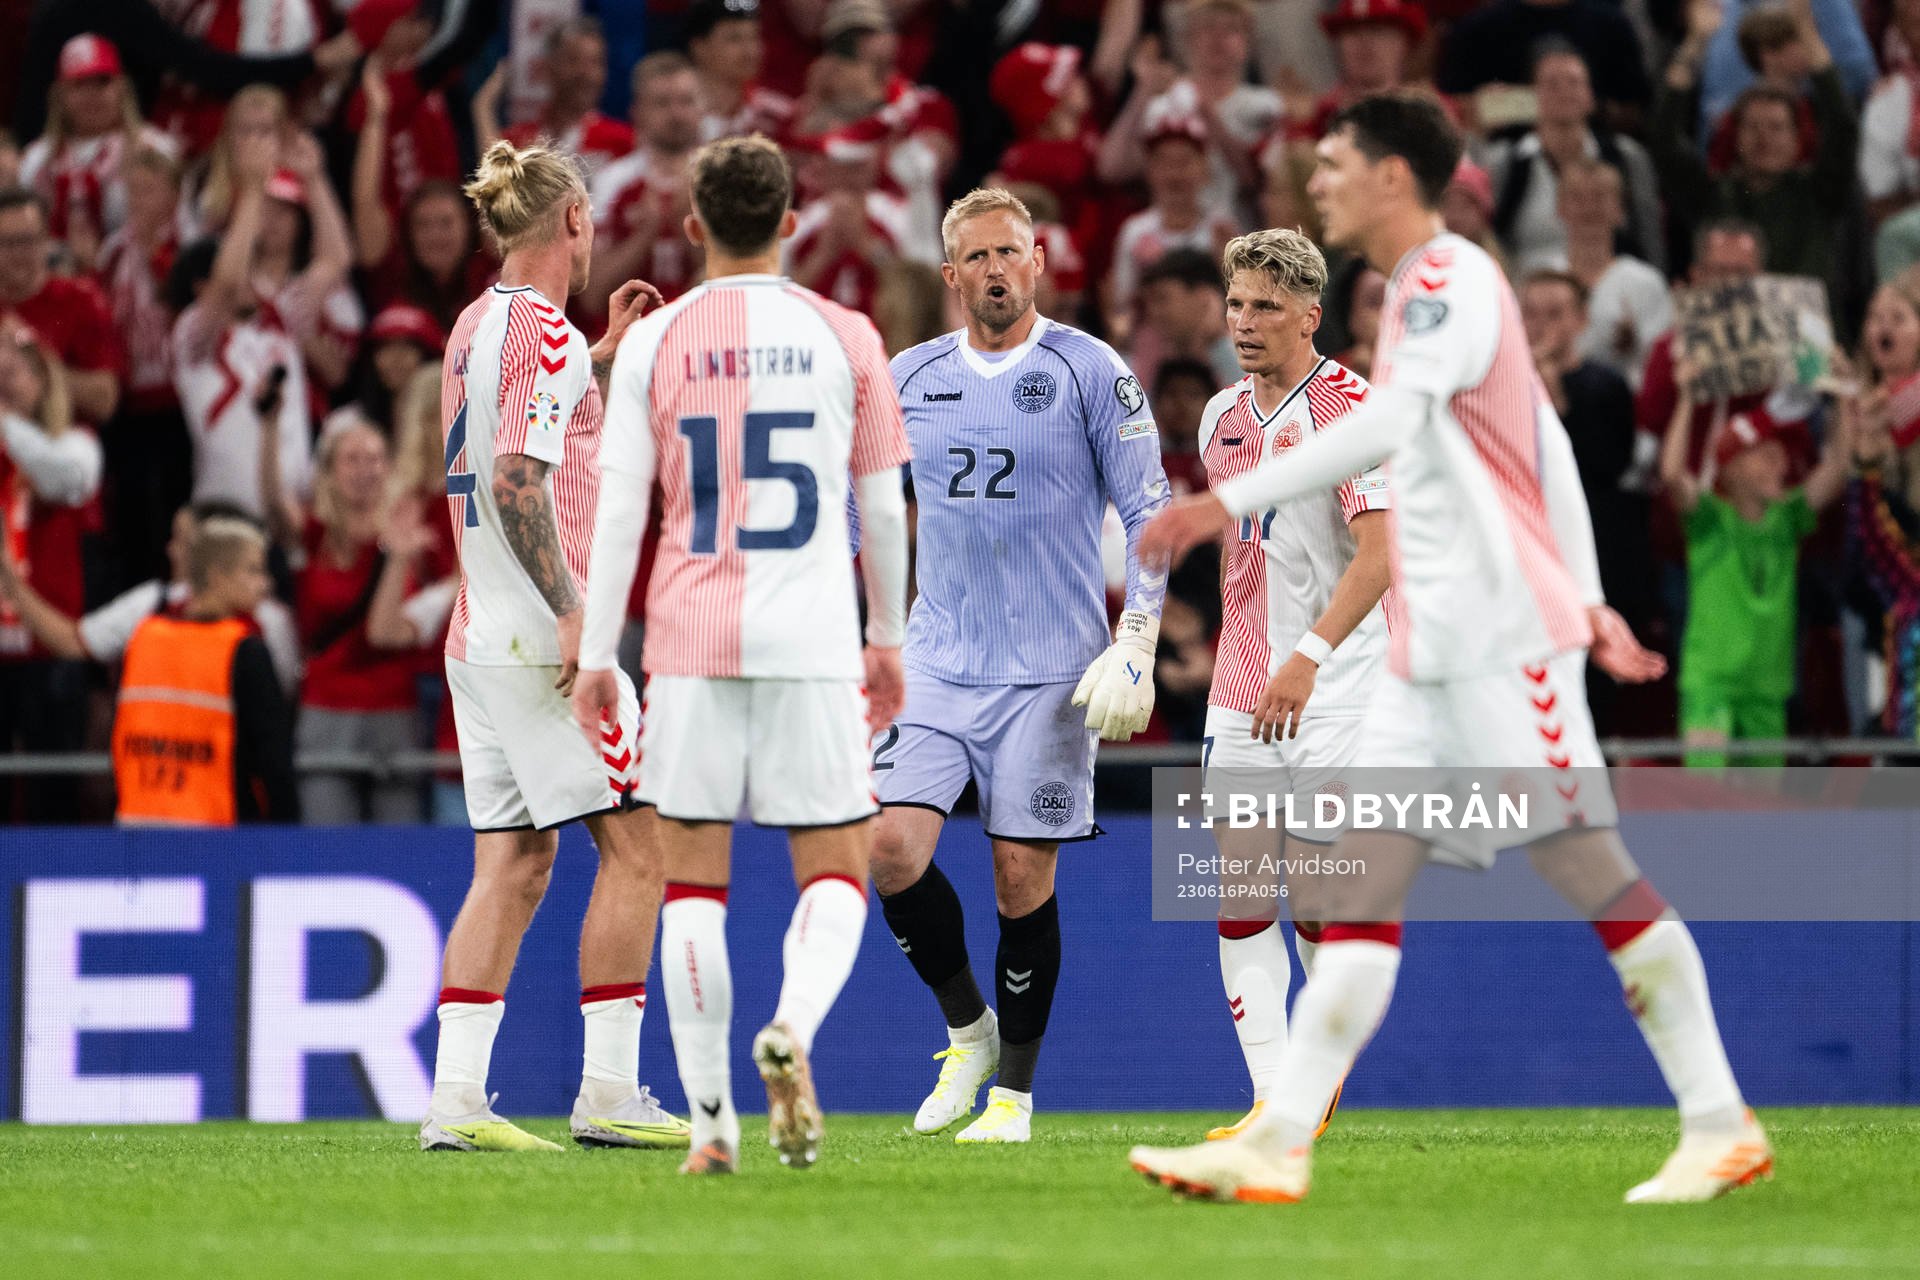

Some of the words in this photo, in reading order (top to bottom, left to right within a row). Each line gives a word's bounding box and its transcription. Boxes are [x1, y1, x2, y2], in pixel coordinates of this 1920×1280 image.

[922, 389, 963, 402] hummel
[1022, 385, 1047, 397] DBU
[678, 411, 819, 554] 15
[947, 447, 1017, 499] 22
[1041, 797, 1067, 809] DBU
[22, 876, 441, 1123] ER
